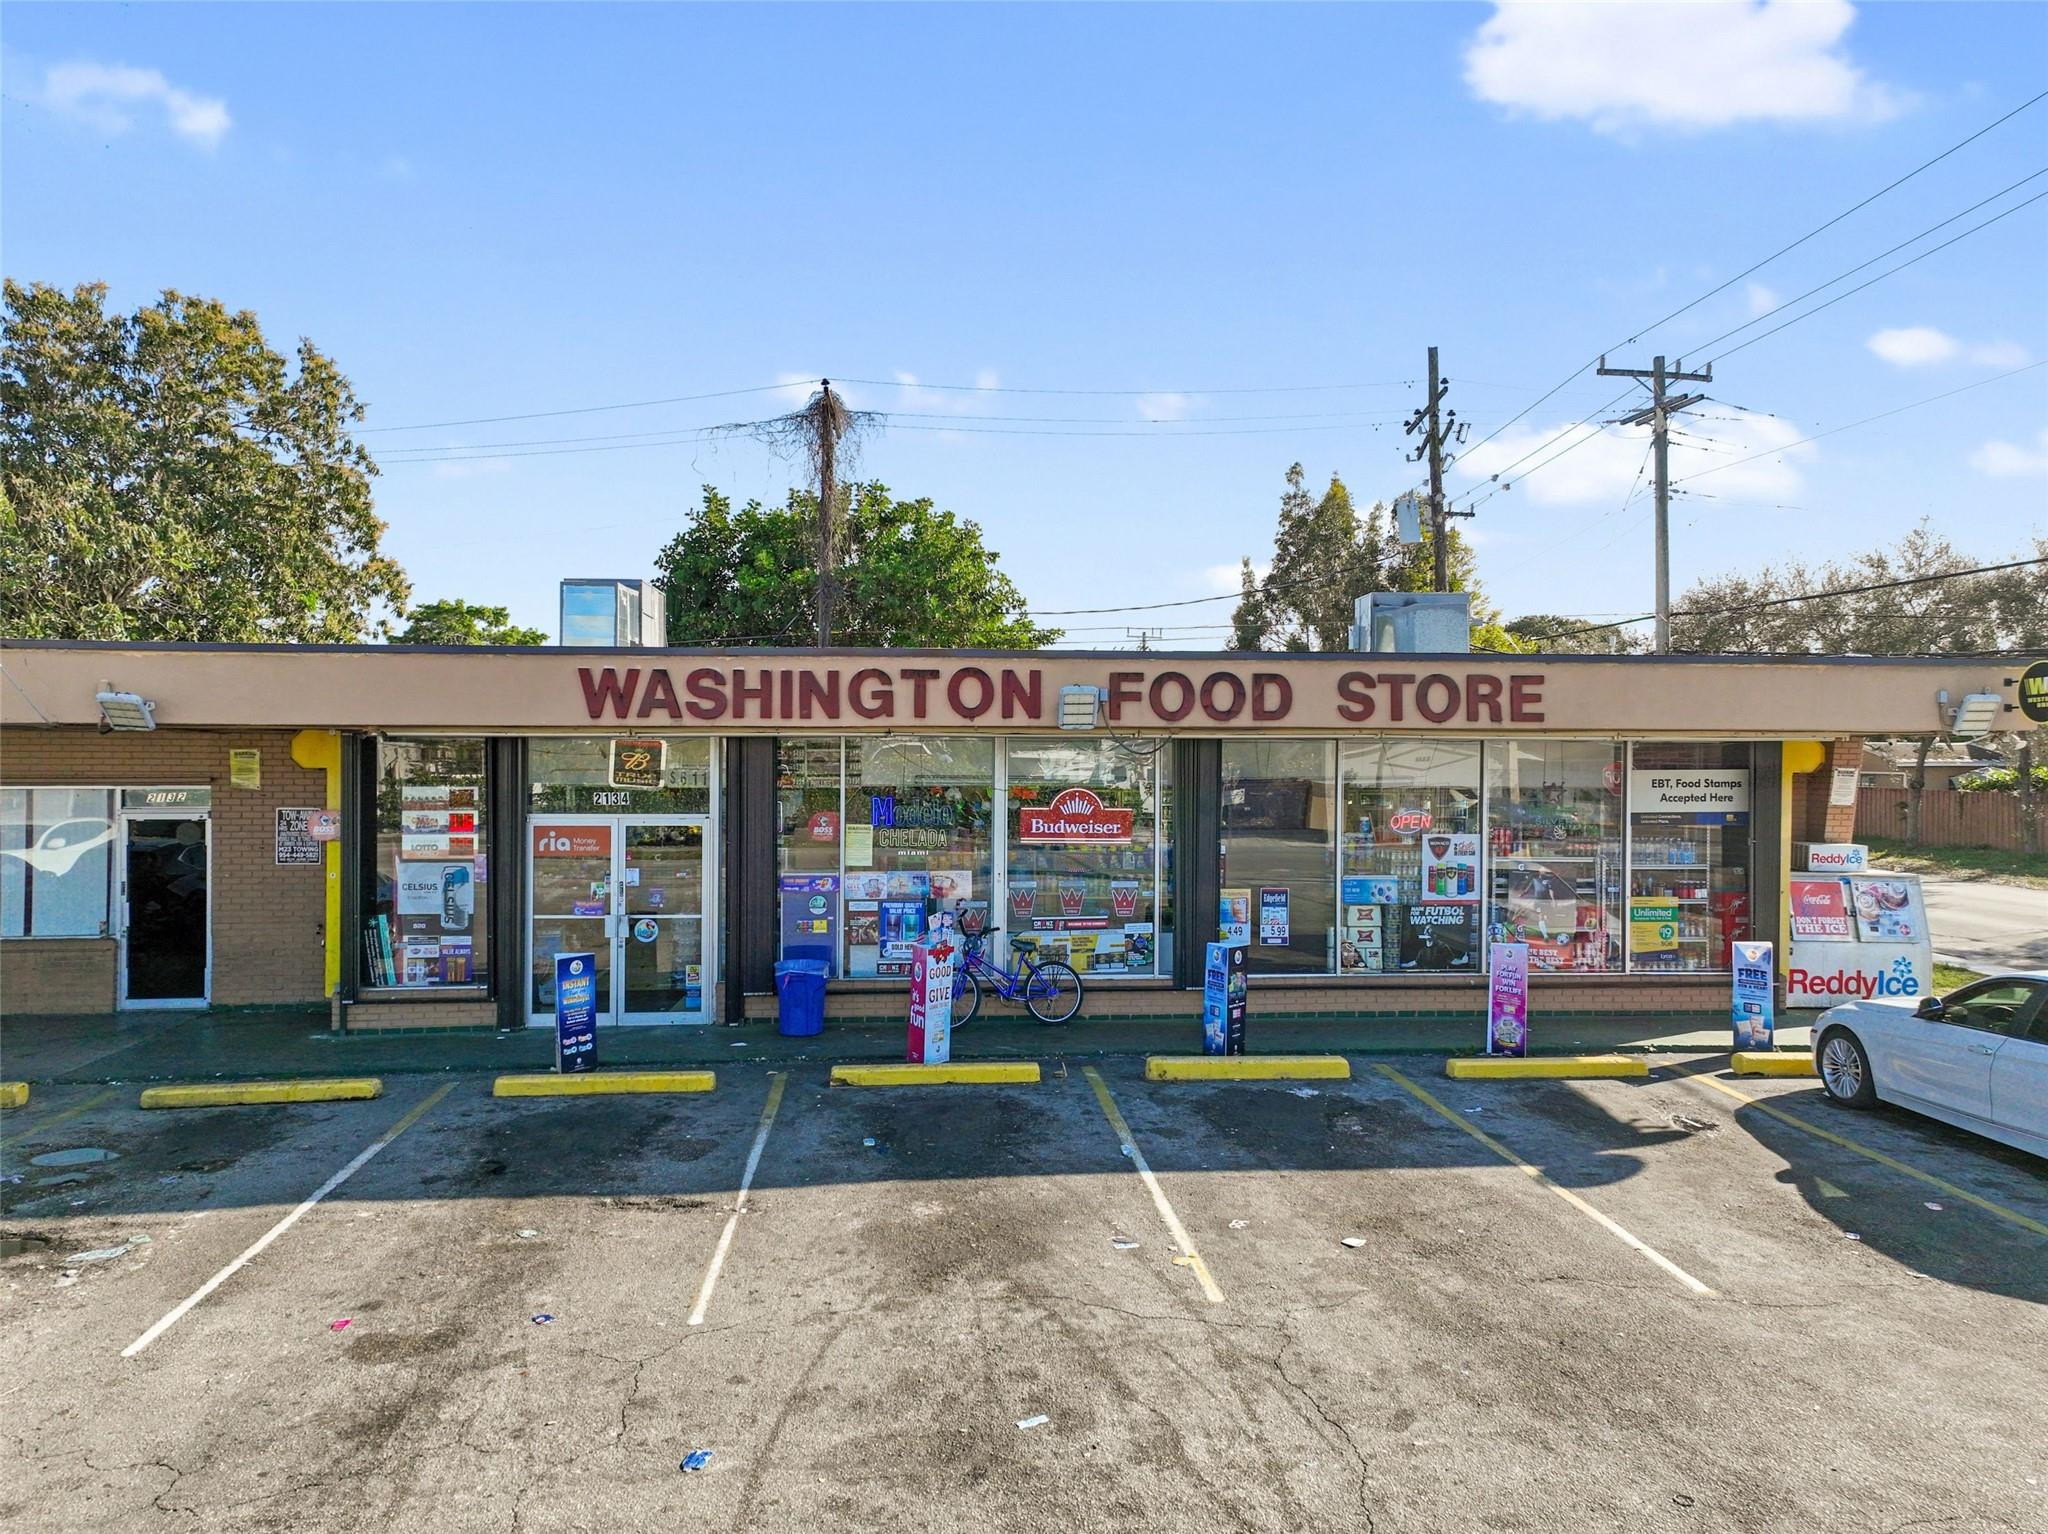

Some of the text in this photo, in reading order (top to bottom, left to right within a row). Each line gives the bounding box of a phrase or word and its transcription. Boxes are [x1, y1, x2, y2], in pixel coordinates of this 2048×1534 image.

[578, 666, 1546, 723] WASHINGTON FOOD STORE
[1651, 778, 1743, 790] EBT, Food Stamps
[146, 792, 187, 803] 2132
[594, 793, 629, 805] 2134
[1660, 793, 1734, 805] Accepted Here
[290, 820, 308, 831] ZONE
[1030, 818, 1121, 834] Budweiser
[1390, 815, 1433, 829] OPEN
[813, 826, 834, 834] BOSS
[539, 831, 571, 852] ria
[574, 836, 597, 845] Money
[879, 829, 948, 847] CHELADA
[411, 844, 439, 852] LOTTO
[1811, 853, 1863, 866] ReddyIce
[402, 883, 438, 891] CELSIUS
[1263, 893, 1286, 903] Edgefield
[1425, 905, 1465, 915] FUTBOL
[1634, 908, 1672, 917] Unlimited
[1410, 915, 1464, 925] WATCHING
[1227, 926, 1243, 936] 4.49
[1270, 925, 1287, 936] 5.99
[1796, 923, 1849, 934] THE ICE
[929, 966, 951, 981] GOOD
[1500, 963, 1518, 973] PLAY
[1208, 969, 1225, 982] FREE
[1509, 972, 1523, 981] FUN
[1738, 967, 1768, 981] FREE
[1500, 978, 1516, 987] WIN
[1788, 968, 1919, 1000] ReddyIce
[912, 988, 920, 1003] it's
[928, 986, 950, 1003] GIVE
[1495, 985, 1522, 996] FOR LIFE
[910, 1005, 925, 1030] fun
